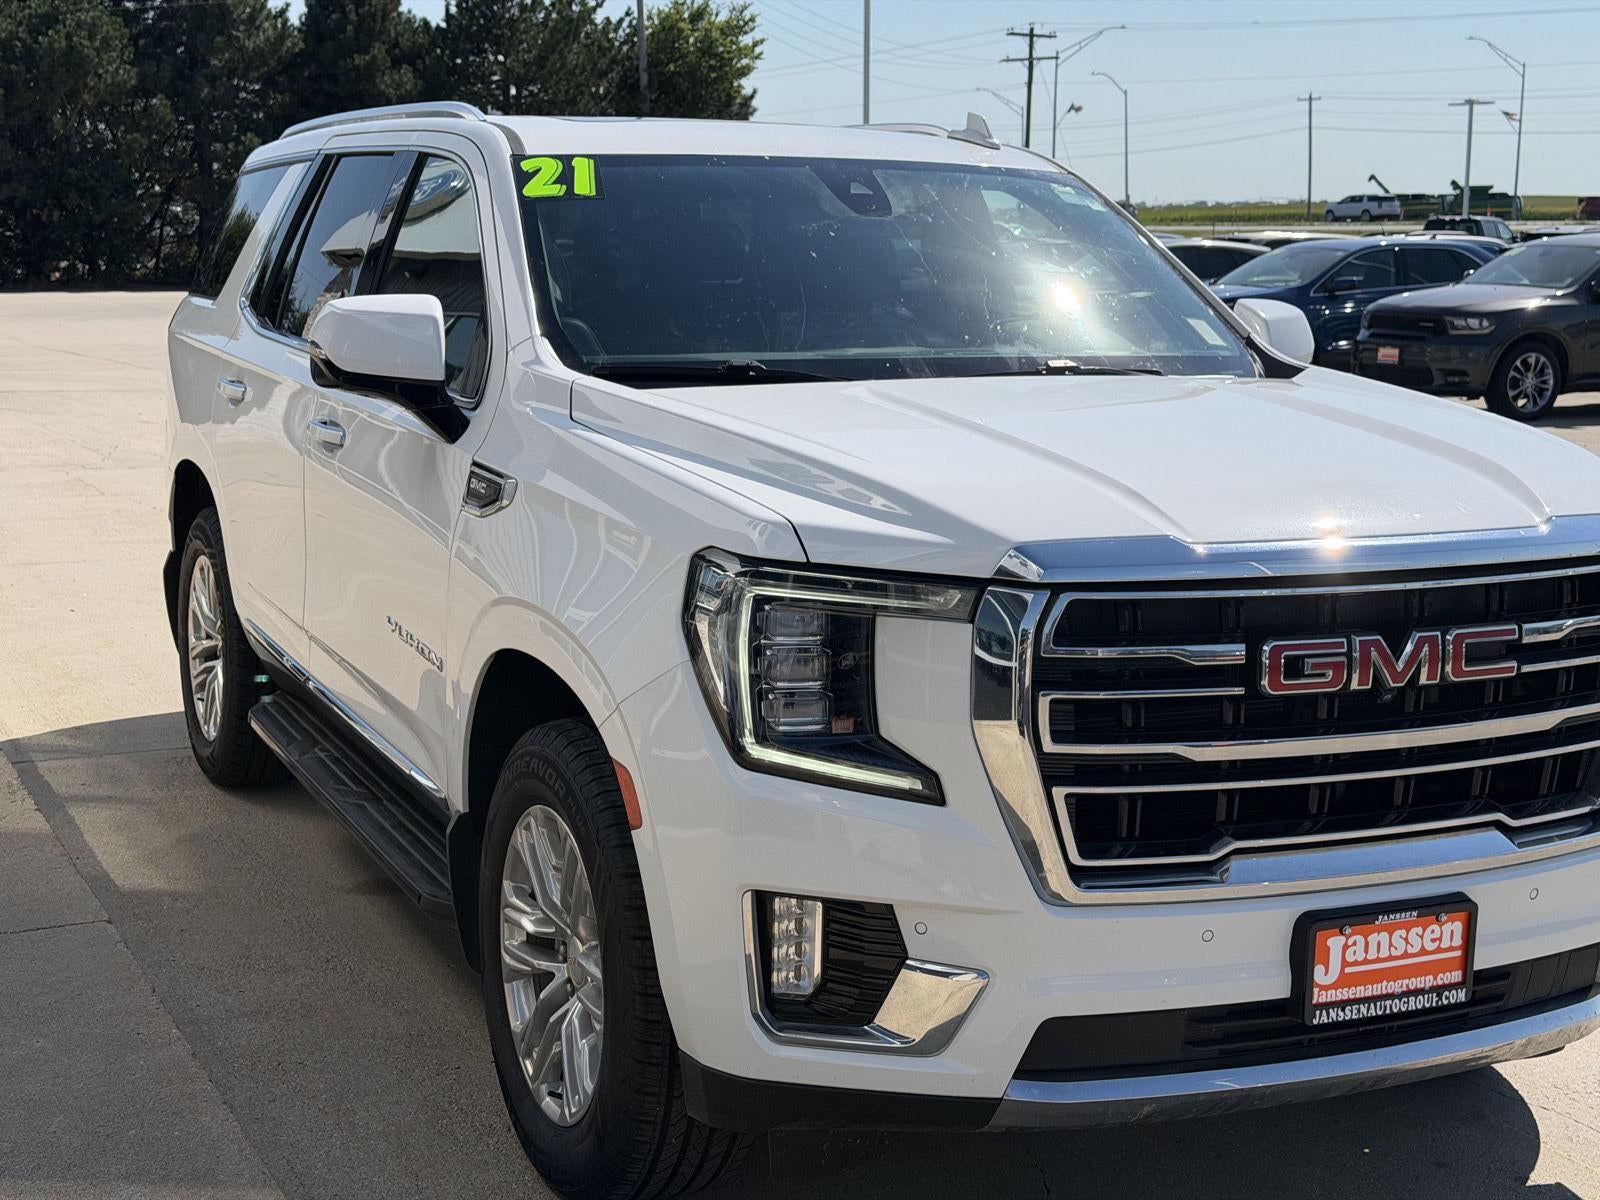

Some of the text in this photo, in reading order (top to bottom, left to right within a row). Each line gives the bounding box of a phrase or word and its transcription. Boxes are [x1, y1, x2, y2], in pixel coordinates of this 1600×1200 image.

[520, 157, 597, 197] 21
[470, 477, 487, 494] GMC
[386, 615, 443, 673] YUKON
[1260, 624, 1519, 696] GMC
[1375, 911, 1418, 924] JANSSEN
[1313, 920, 1463, 986] Janssen
[1312, 970, 1463, 1005] Janssenautogroup.com
[1312, 988, 1467, 1025] JANSSENAUTOGROUP.COM
